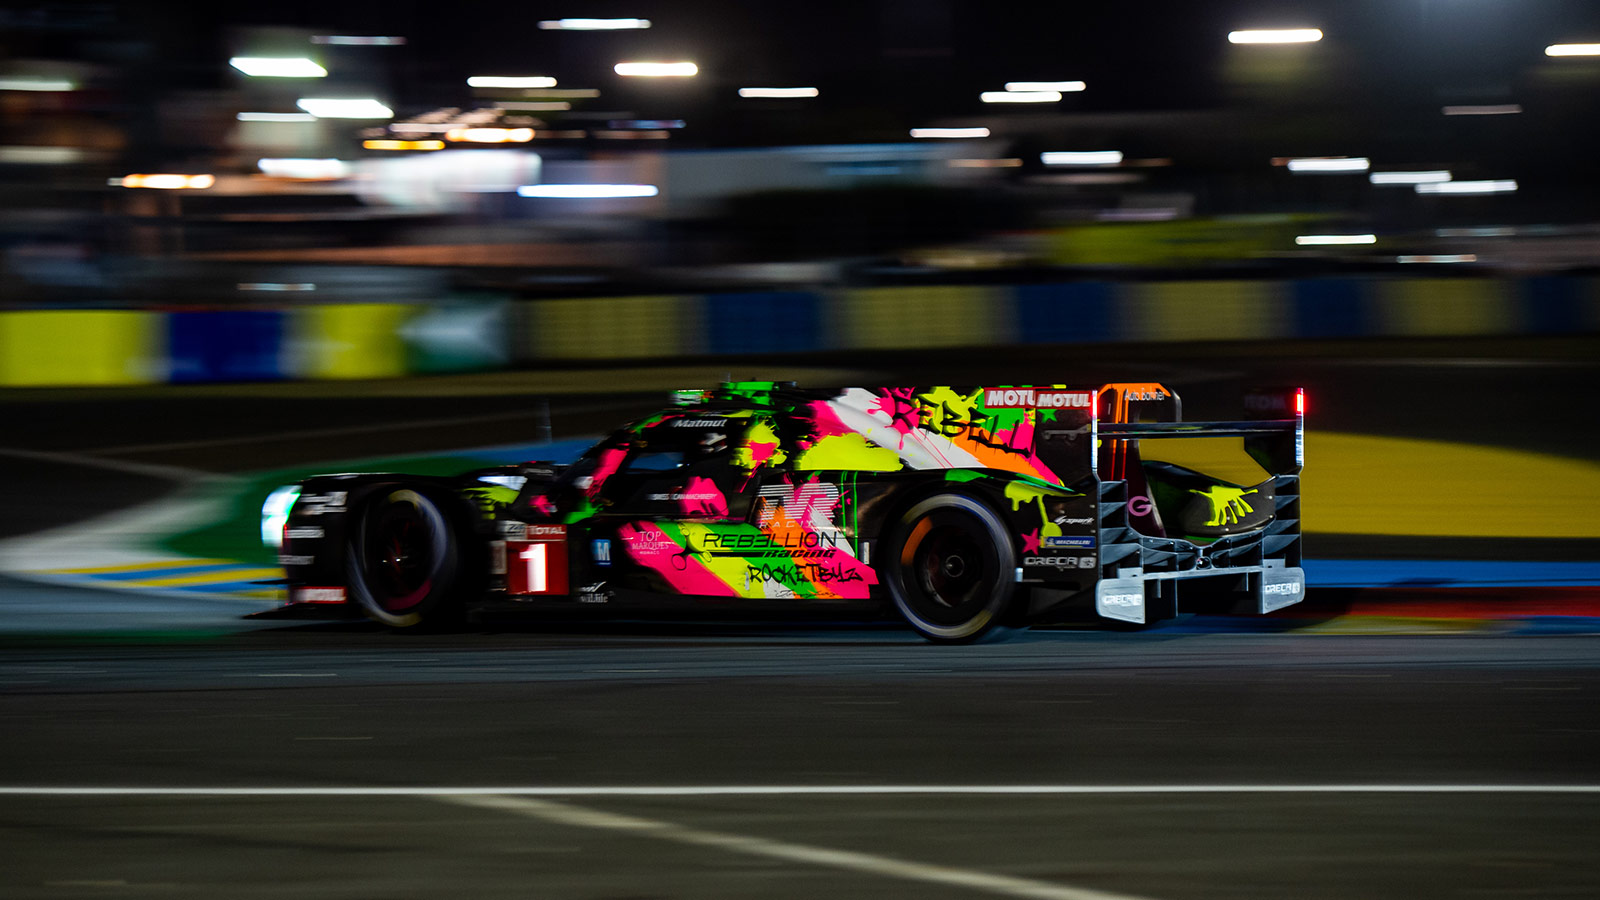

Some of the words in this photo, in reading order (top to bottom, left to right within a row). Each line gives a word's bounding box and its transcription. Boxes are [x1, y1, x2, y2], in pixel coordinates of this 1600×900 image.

[987, 389, 1035, 406] MOTU
[1036, 392, 1091, 408] MOTUL
[672, 418, 727, 428] Matmut
[529, 525, 566, 535] TOTAL
[638, 530, 661, 542] TOP
[704, 531, 837, 548] REBELLION
[632, 541, 669, 551] MARQUES
[1024, 556, 1078, 566] ORECA
[519, 543, 547, 592] 1
